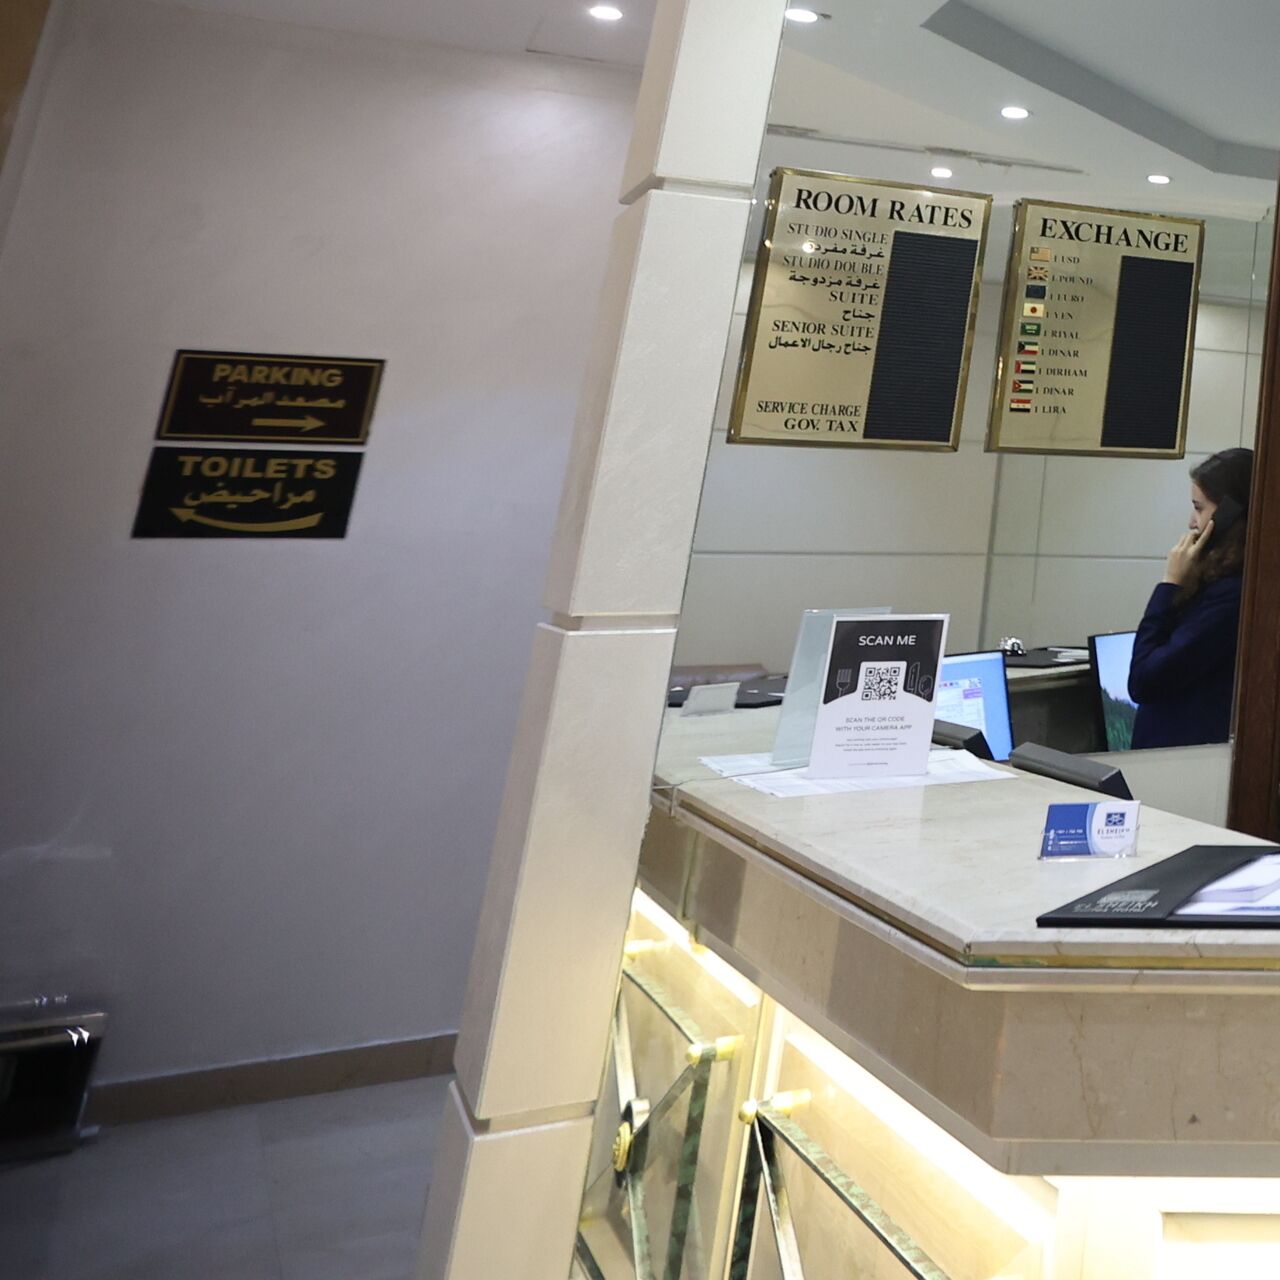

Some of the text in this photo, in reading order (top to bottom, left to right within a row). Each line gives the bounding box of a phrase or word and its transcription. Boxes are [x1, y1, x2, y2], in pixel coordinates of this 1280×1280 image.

[794, 188, 974, 229] ROOM RATES
[787, 223, 889, 245] STUDIO SINGLE
[1039, 217, 1189, 254] EXCHANGE
[849, 243, 886, 259] غرفة
[782, 255, 885, 276] STUDIO DOUBLE
[1061, 256, 1080, 264] USD
[788, 269, 881, 291] غرفة مزدوجة
[1059, 275, 1093, 285] POUND
[828, 290, 879, 306] SUITE
[1057, 294, 1084, 303] EURO
[842, 308, 875, 322] جناح
[1054, 310, 1073, 320] YEN
[771, 320, 875, 339] SENIOR SUITE
[1051, 330, 1079, 340] RIYAL
[811, 338, 842, 354] رجال
[843, 342, 871, 355] جناح
[1048, 348, 1080, 358] DINAR
[212, 363, 344, 388] PARKING
[1046, 368, 1088, 378] DIRHAM
[1043, 387, 1075, 396] DINAR
[275, 392, 346, 409] مصعد
[756, 400, 862, 417] SERVICE CHARGE
[1042, 406, 1067, 414] LIRA
[783, 417, 859, 432] GOV. TAX
[177, 455, 337, 480] TOILETS
[183, 481, 317, 510] مراحيض
[858, 634, 917, 646] SCAN ME
[872, 724, 898, 732] CAMERA
